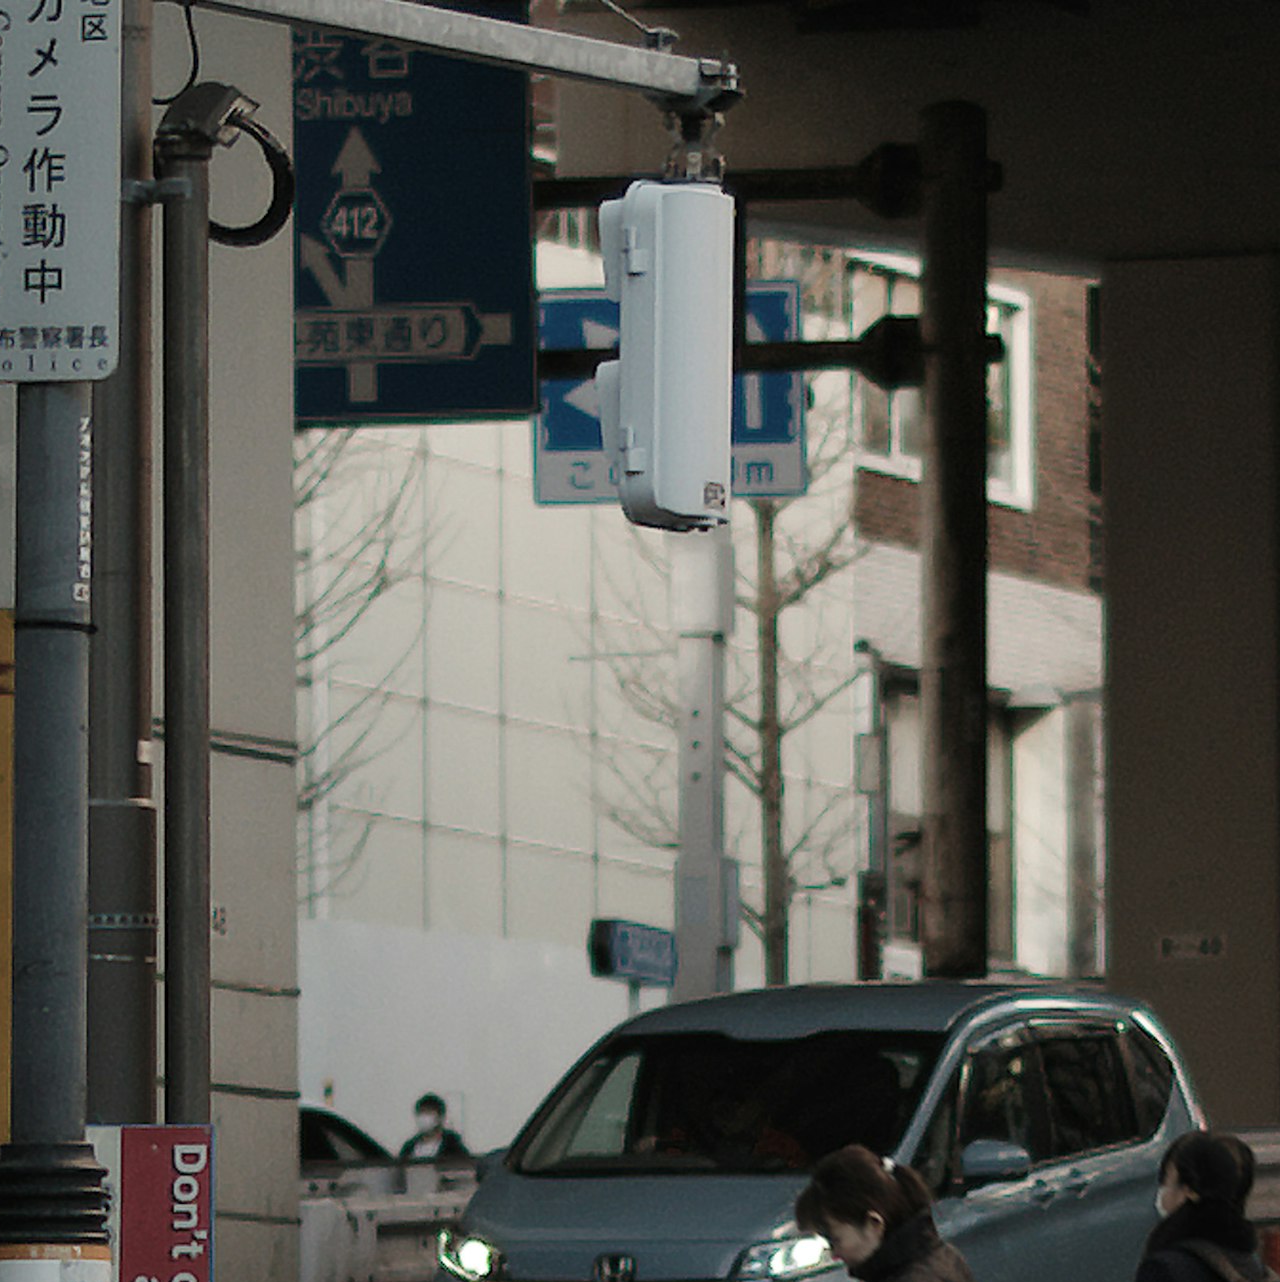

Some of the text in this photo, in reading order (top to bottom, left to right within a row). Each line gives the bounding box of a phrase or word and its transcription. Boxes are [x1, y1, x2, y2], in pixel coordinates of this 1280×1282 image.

[81, 0, 109, 41] 区
[297, 88, 413, 124] Shibuya
[23, 0, 66, 305] カメラ作動中
[331, 206, 378, 239] 412
[296, 315, 448, 352] 苑東通り
[170, 1143, 207, 1261] Don't
